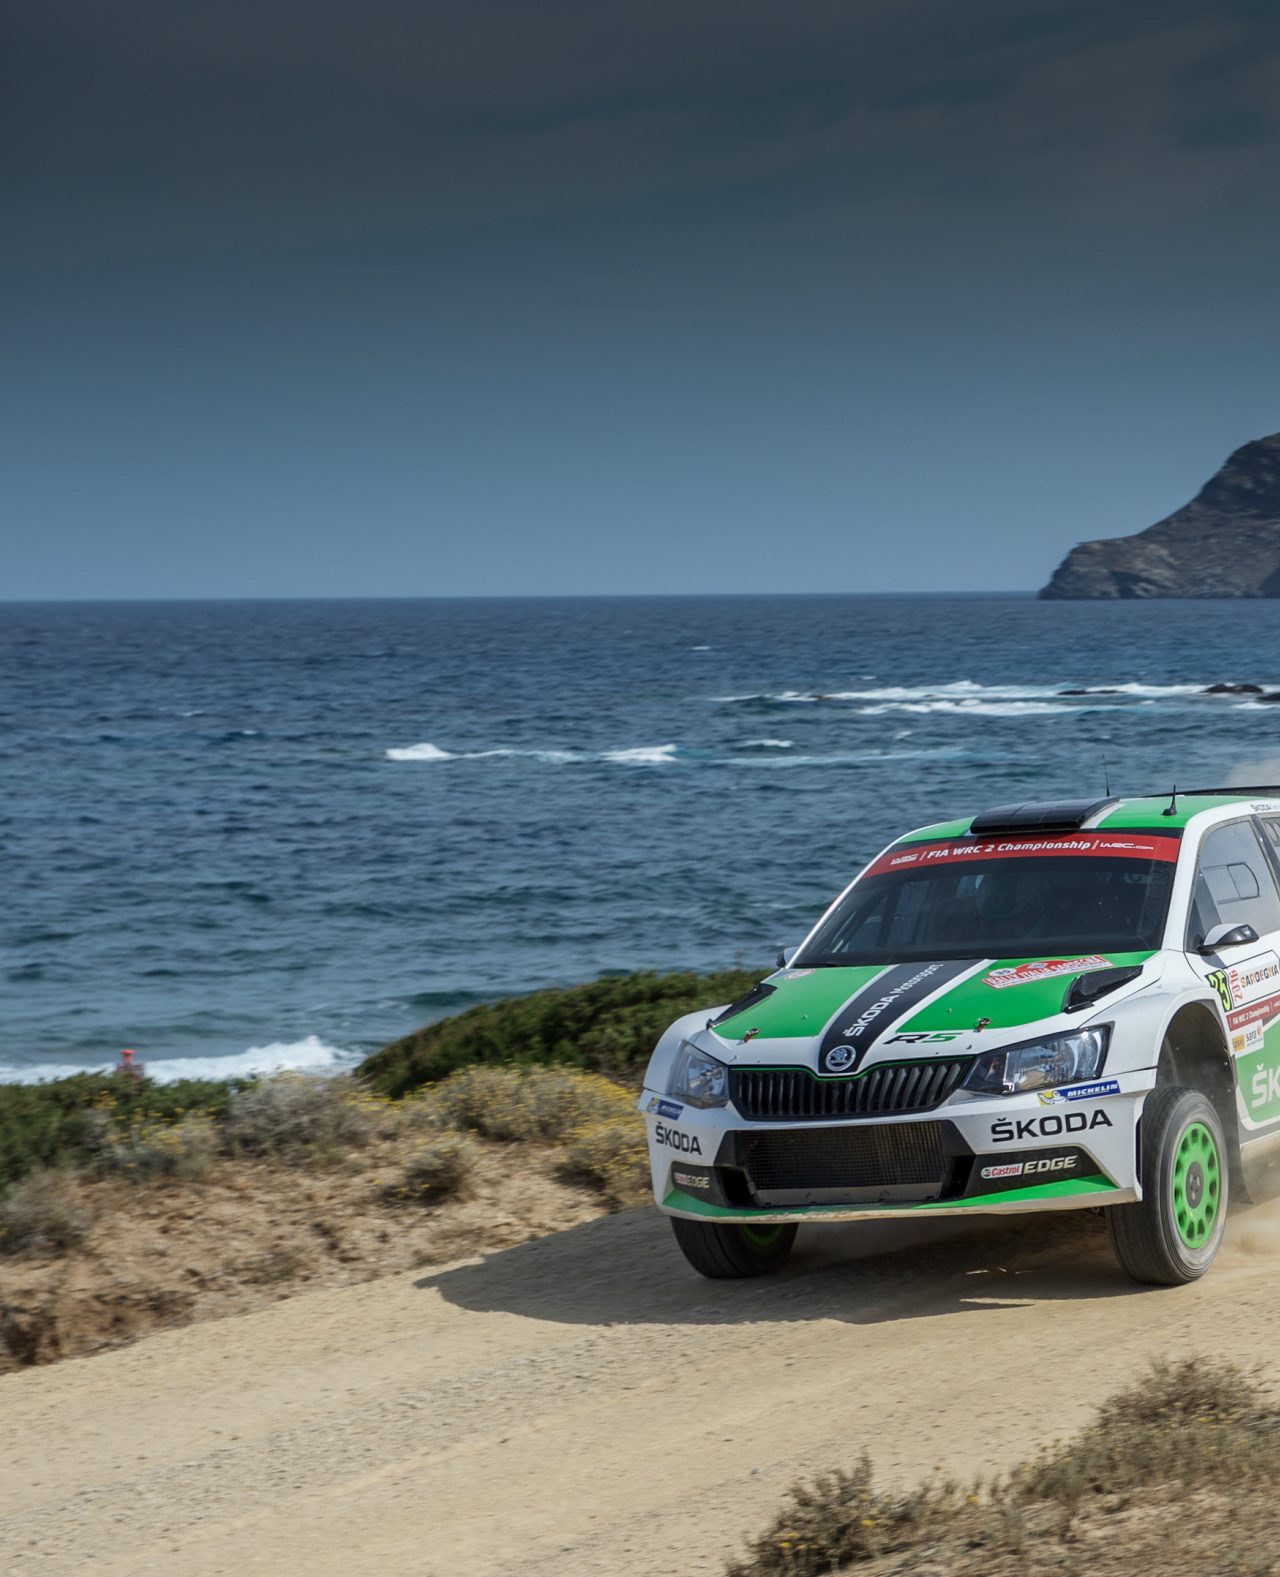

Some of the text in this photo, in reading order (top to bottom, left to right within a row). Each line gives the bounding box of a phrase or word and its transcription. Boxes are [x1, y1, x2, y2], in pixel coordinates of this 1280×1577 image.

[927, 849, 949, 859] FIA
[952, 845, 983, 856] WRC
[984, 844, 994, 853] 2
[997, 840, 1091, 852] Championship
[1240, 964, 1280, 988] SARDEGNA
[842, 963, 944, 1037] ŠKODA Motorsport
[882, 1032, 964, 1045] R5
[1067, 1083, 1118, 1098] MICHELIN
[990, 1108, 1114, 1143] ŠKODA
[655, 1121, 703, 1156] ŠKODA
[991, 1154, 1079, 1177] Castrol EDGE
